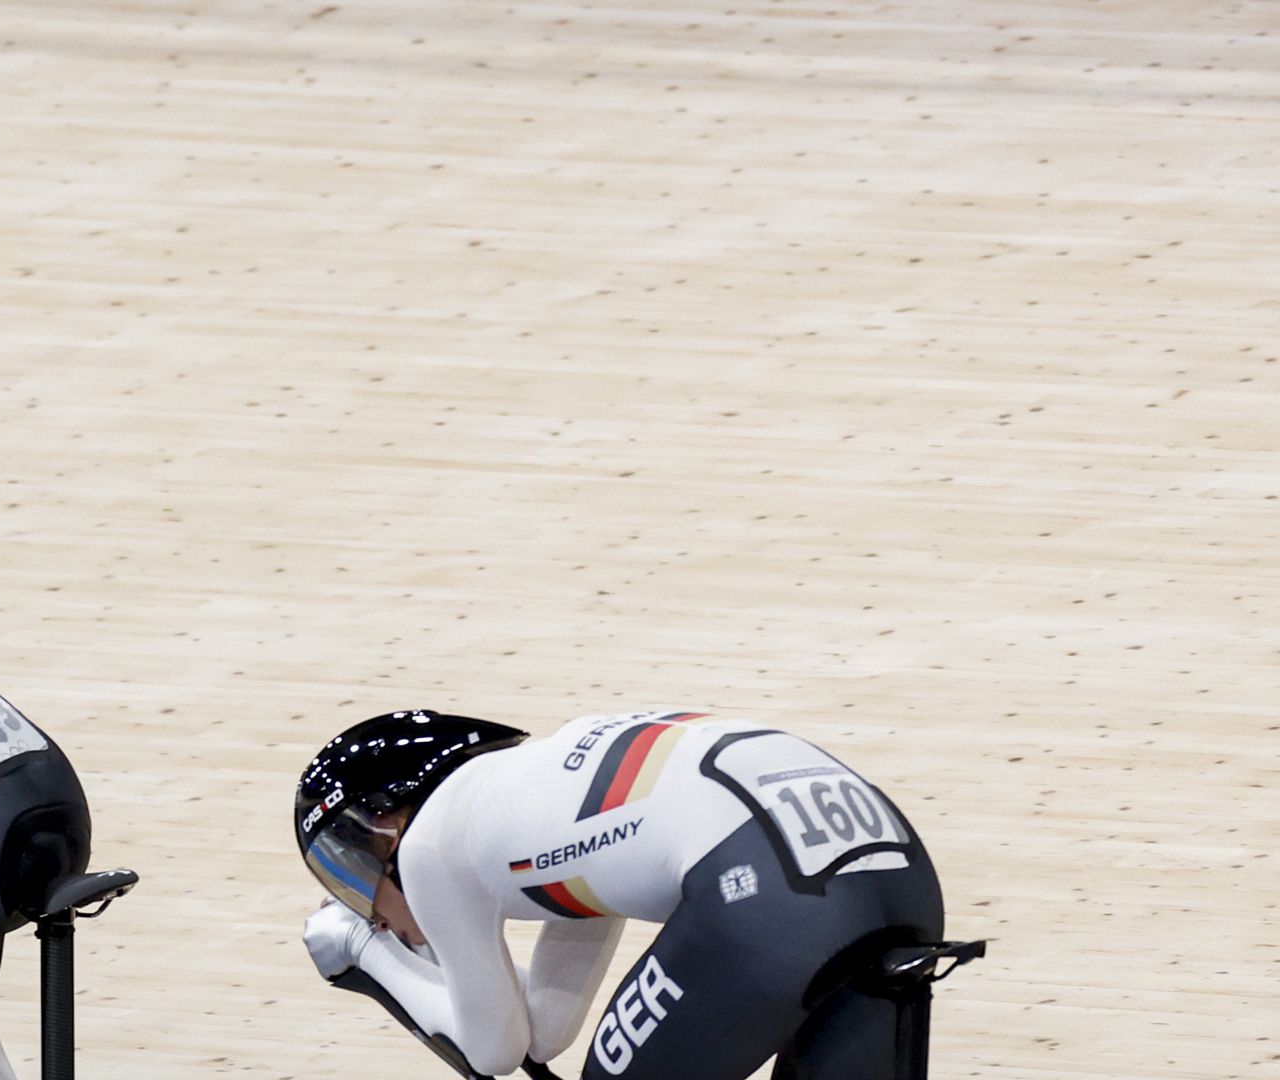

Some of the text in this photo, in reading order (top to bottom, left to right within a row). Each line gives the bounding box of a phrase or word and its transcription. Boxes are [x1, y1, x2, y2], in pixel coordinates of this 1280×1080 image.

[536, 817, 644, 870] GERMANY
[777, 780, 884, 848] 160
[594, 954, 685, 1076] GER
